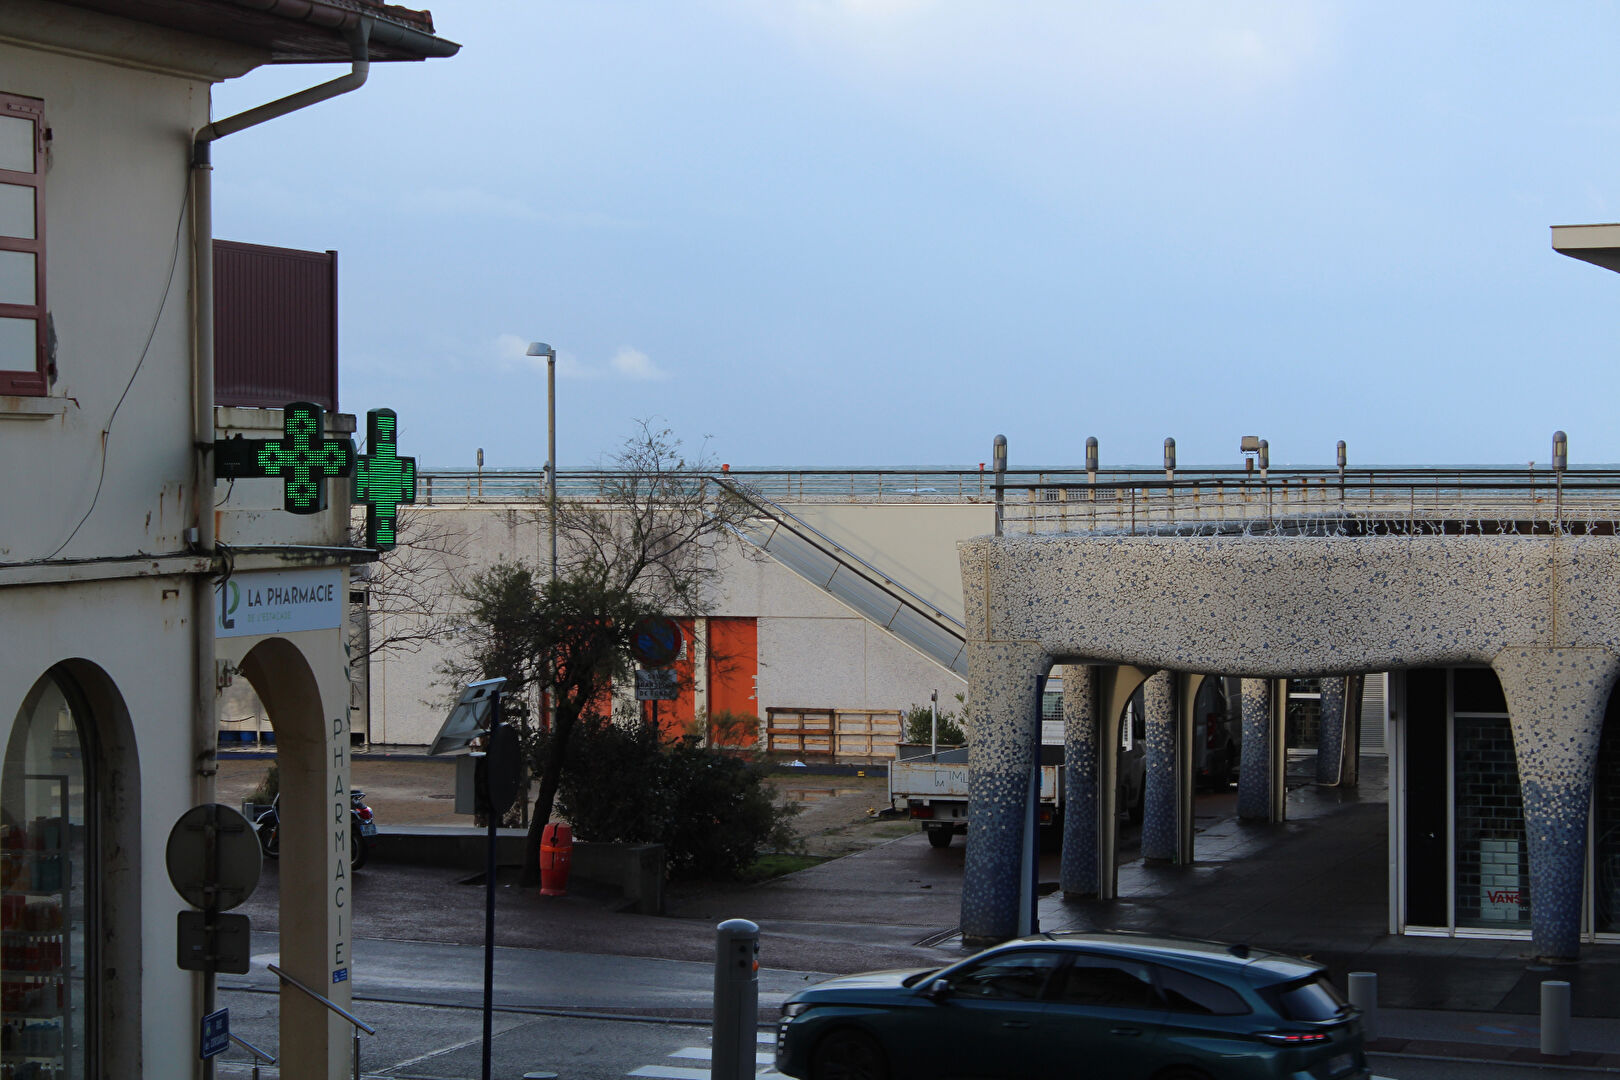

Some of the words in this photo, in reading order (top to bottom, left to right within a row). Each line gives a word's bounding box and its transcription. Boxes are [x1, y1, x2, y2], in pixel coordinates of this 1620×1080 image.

[248, 590, 262, 606] LA
[267, 584, 334, 606] PHARMACIE
[248, 614, 255, 623] DE
[333, 719, 344, 965] PHARMACIE
[1487, 890, 1521, 904] VANS
